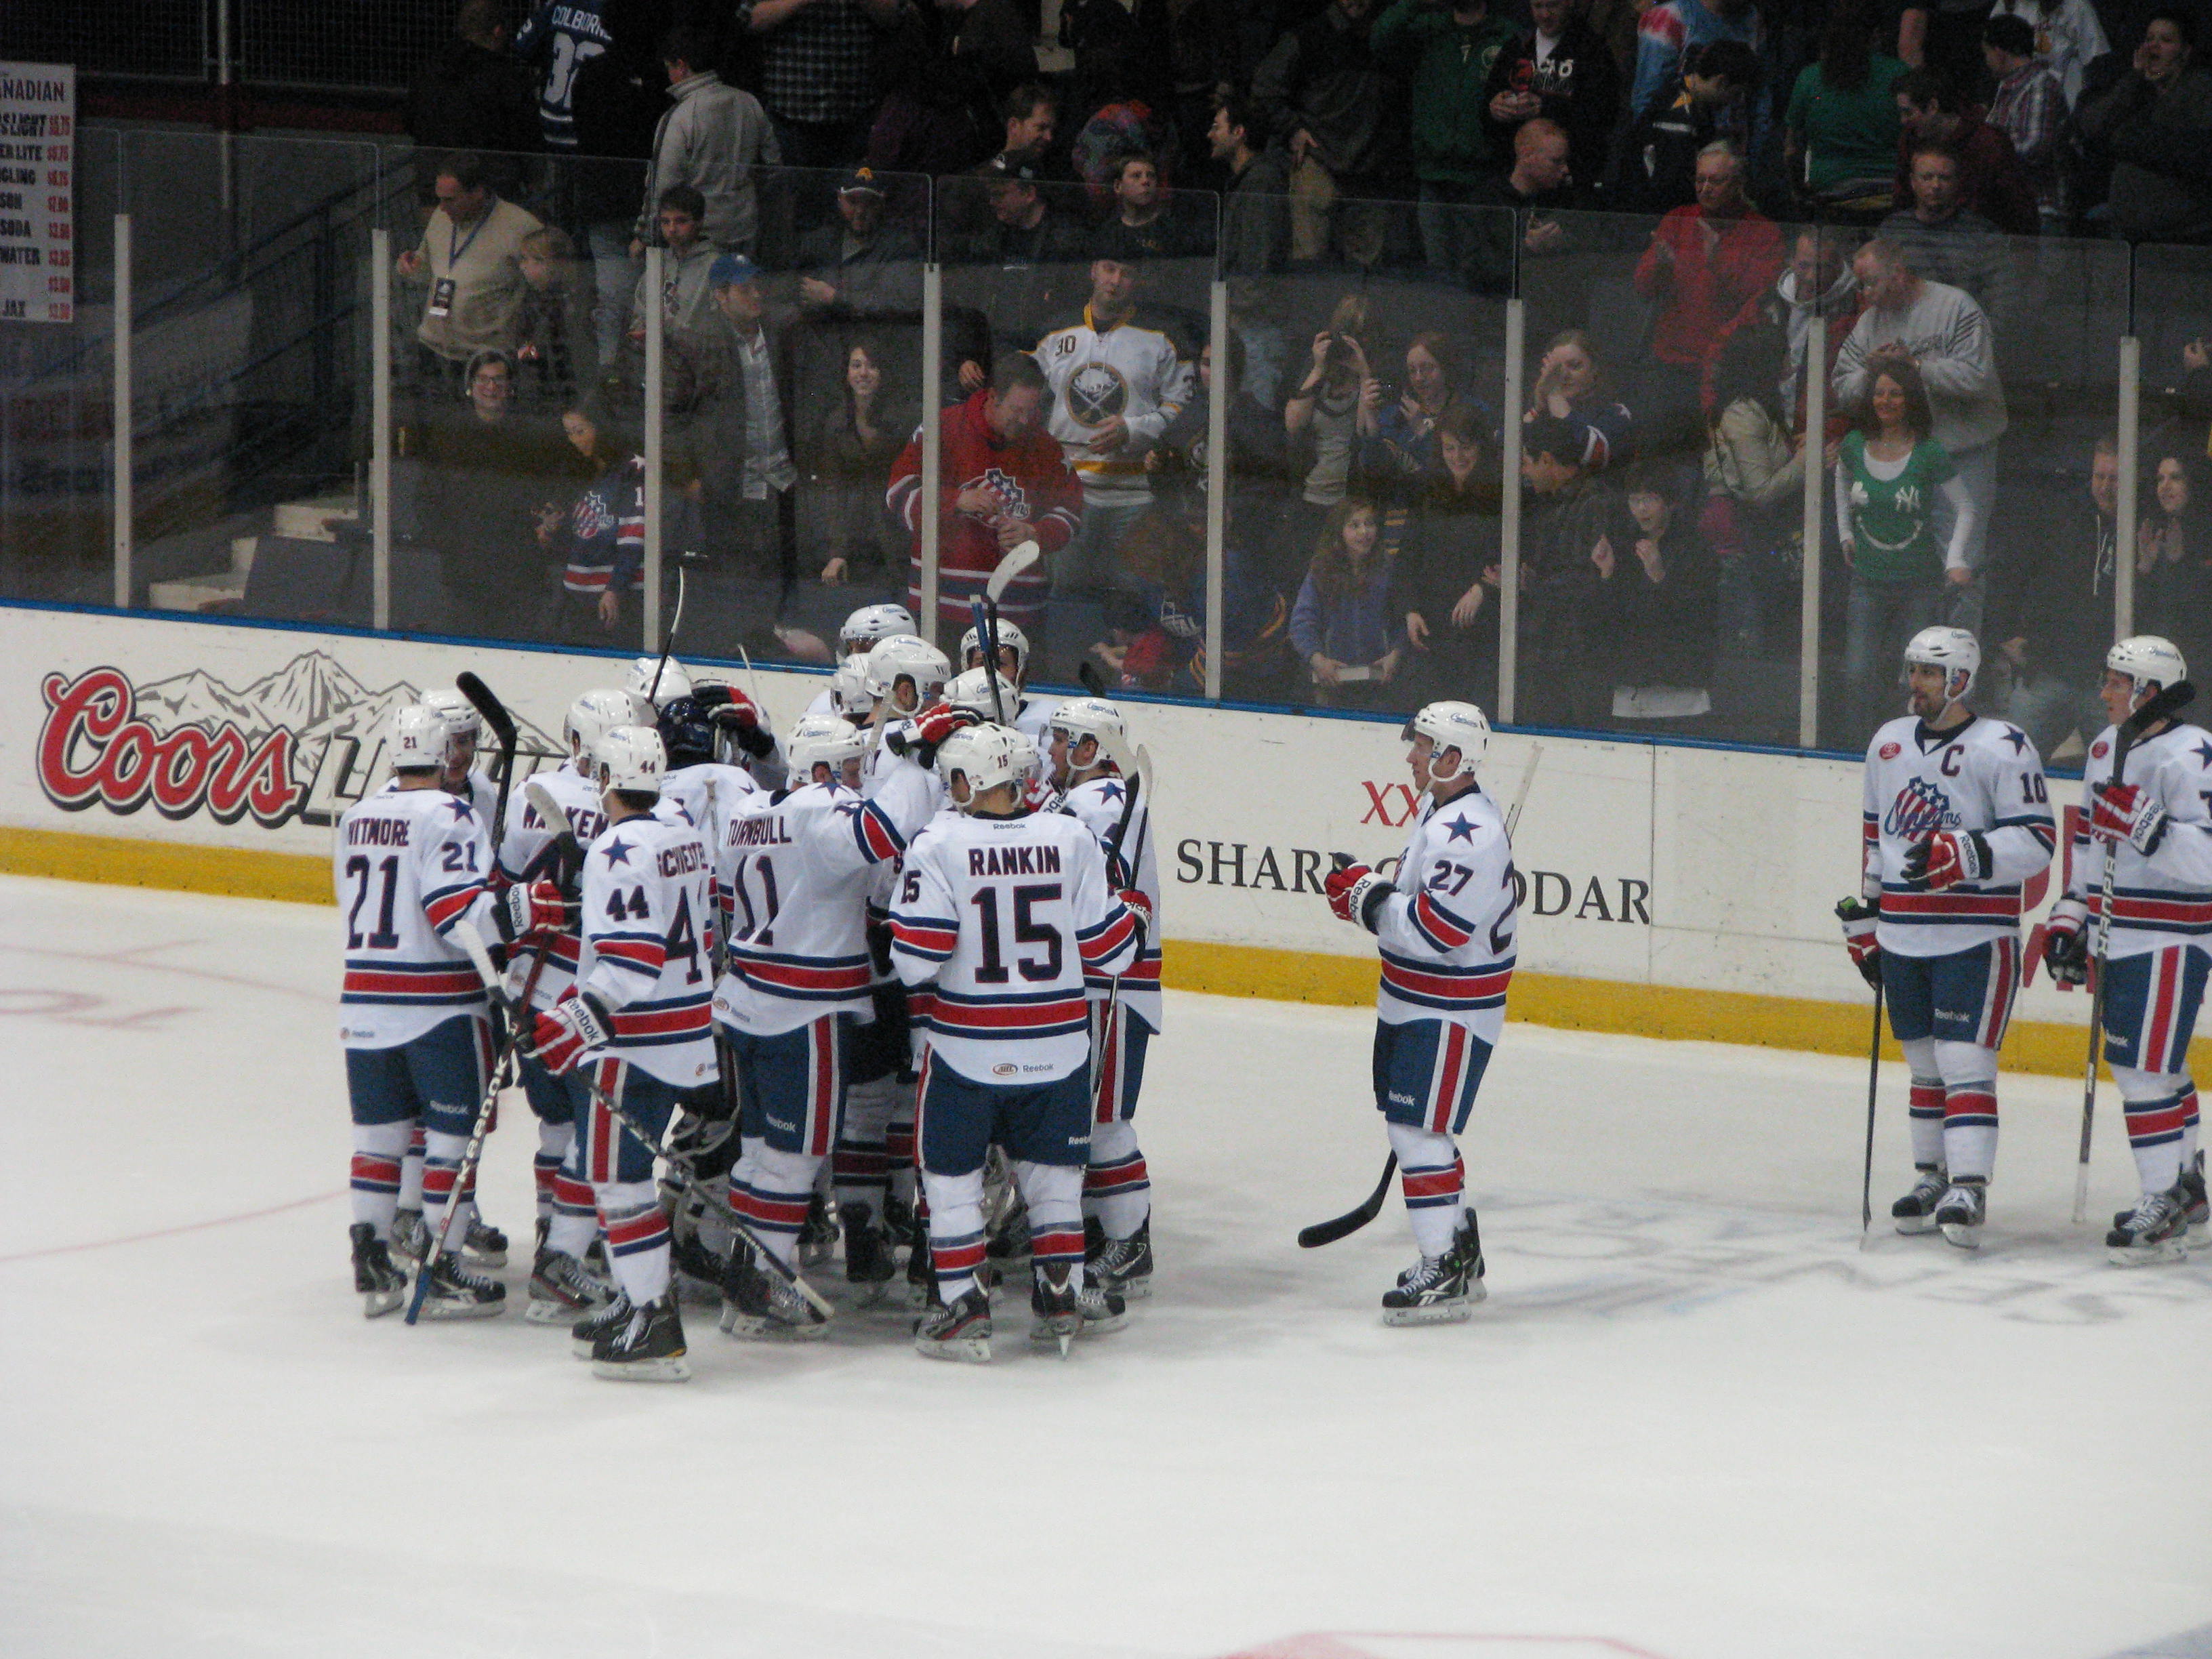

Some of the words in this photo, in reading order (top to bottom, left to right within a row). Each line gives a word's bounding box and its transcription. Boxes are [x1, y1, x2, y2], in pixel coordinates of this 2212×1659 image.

[36, 665, 310, 830] Coors
[1940, 744, 1965, 777] C
[2020, 772, 2048, 804] 10
[441, 841, 478, 873] 21
[968, 846, 1061, 877] RANKIN
[1429, 859, 1475, 897] 27
[346, 855, 400, 949] 21
[606, 884, 650, 922] 44
[970, 883, 1063, 984] 15
